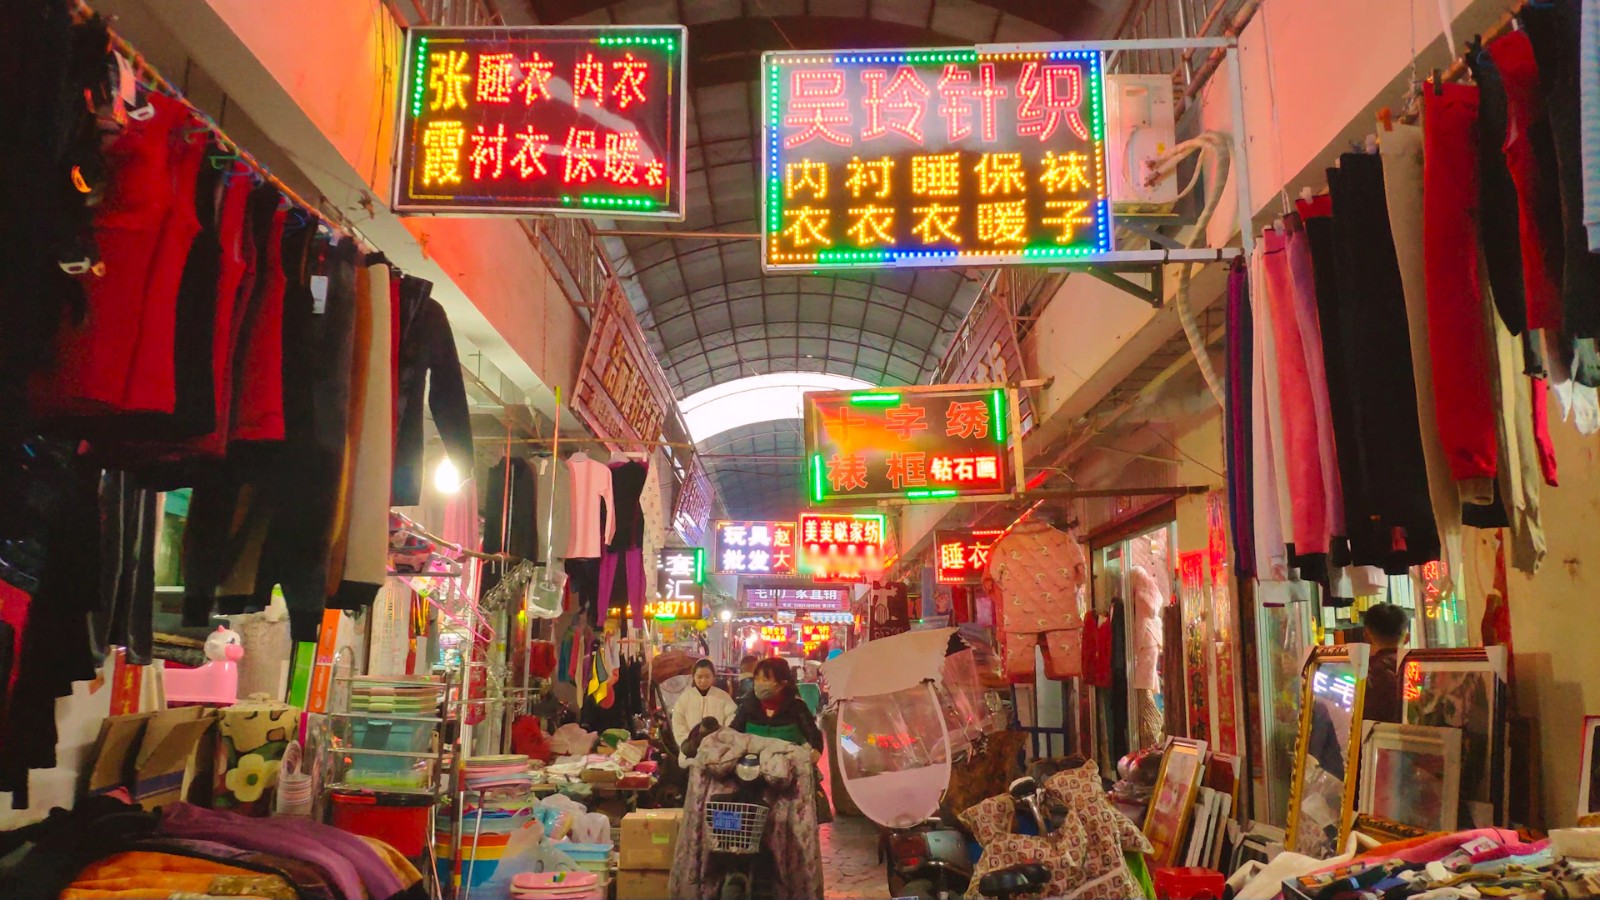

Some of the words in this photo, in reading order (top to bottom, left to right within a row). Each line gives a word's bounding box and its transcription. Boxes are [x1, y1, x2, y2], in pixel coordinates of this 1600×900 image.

[476, 52, 554, 105] 睡衣
[573, 53, 649, 109] 内衣
[784, 61, 1088, 149] 吴玲针织
[424, 50, 471, 187] 张霞
[469, 123, 549, 180] 衬衣
[783, 157, 831, 247] 内衣
[846, 155, 896, 247] 衬衣
[911, 152, 961, 245] 睡衣
[974, 152, 1028, 245] 保暖
[1040, 150, 1093, 243] 袜子
[823, 400, 989, 441] 十字绣
[827, 451, 928, 491] 裱框
[930, 456, 997, 481] 钻石画
[723, 549, 770, 571] 批发
[724, 526, 771, 546] 玩具
[773, 528, 791, 568] 赵大
[941, 541, 991, 569] 睡衣
[655, 578, 695, 600] 汇
